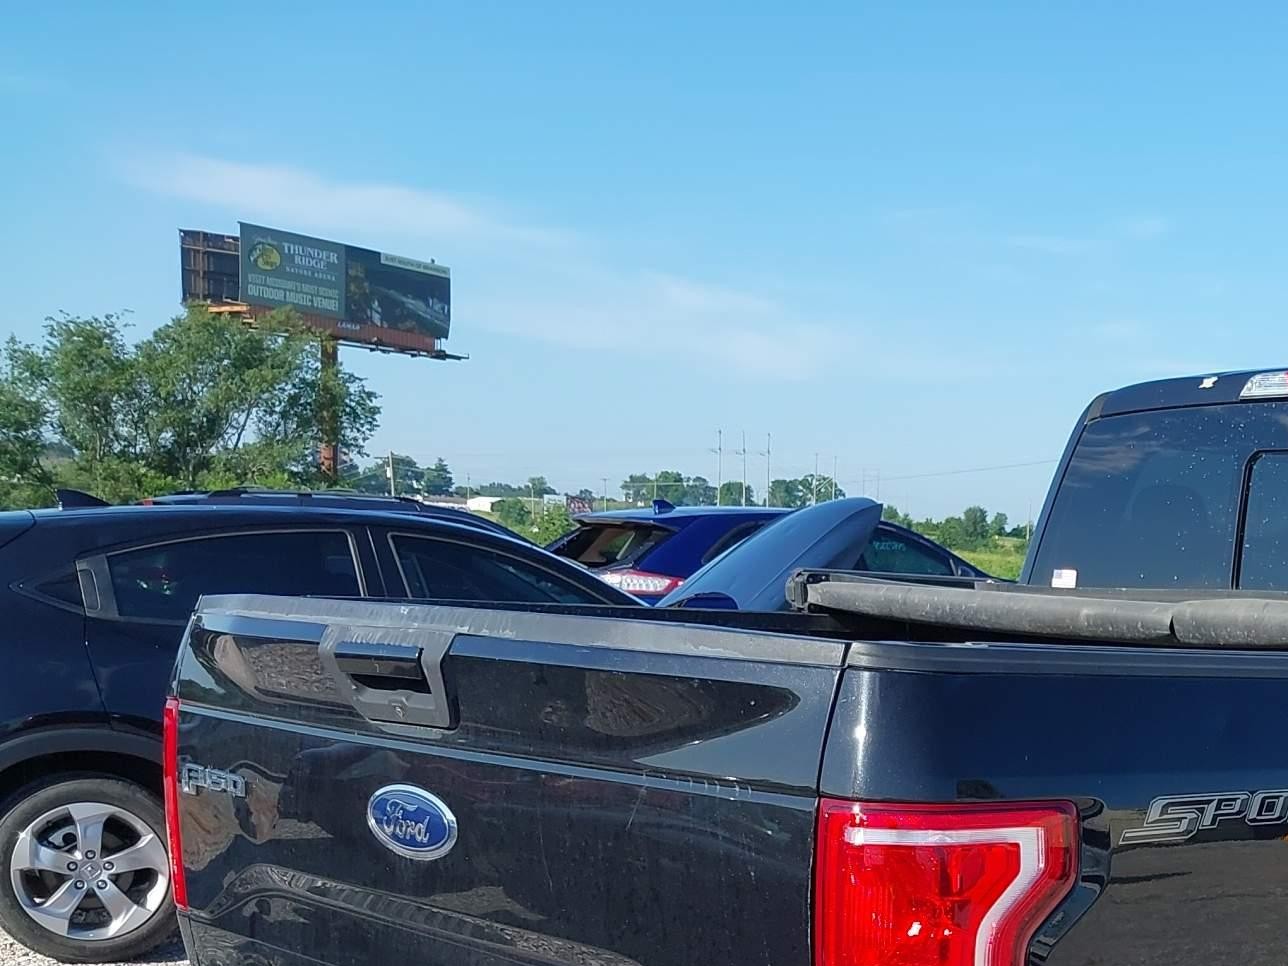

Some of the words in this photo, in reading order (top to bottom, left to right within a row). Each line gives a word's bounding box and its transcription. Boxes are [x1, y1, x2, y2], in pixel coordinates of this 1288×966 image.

[282, 241, 338, 264] THUNDER
[294, 254, 328, 270] RIDGE
[247, 284, 285, 301] OUTDOOR
[286, 291, 312, 306] MUSIC
[383, 799, 430, 843] Ford
